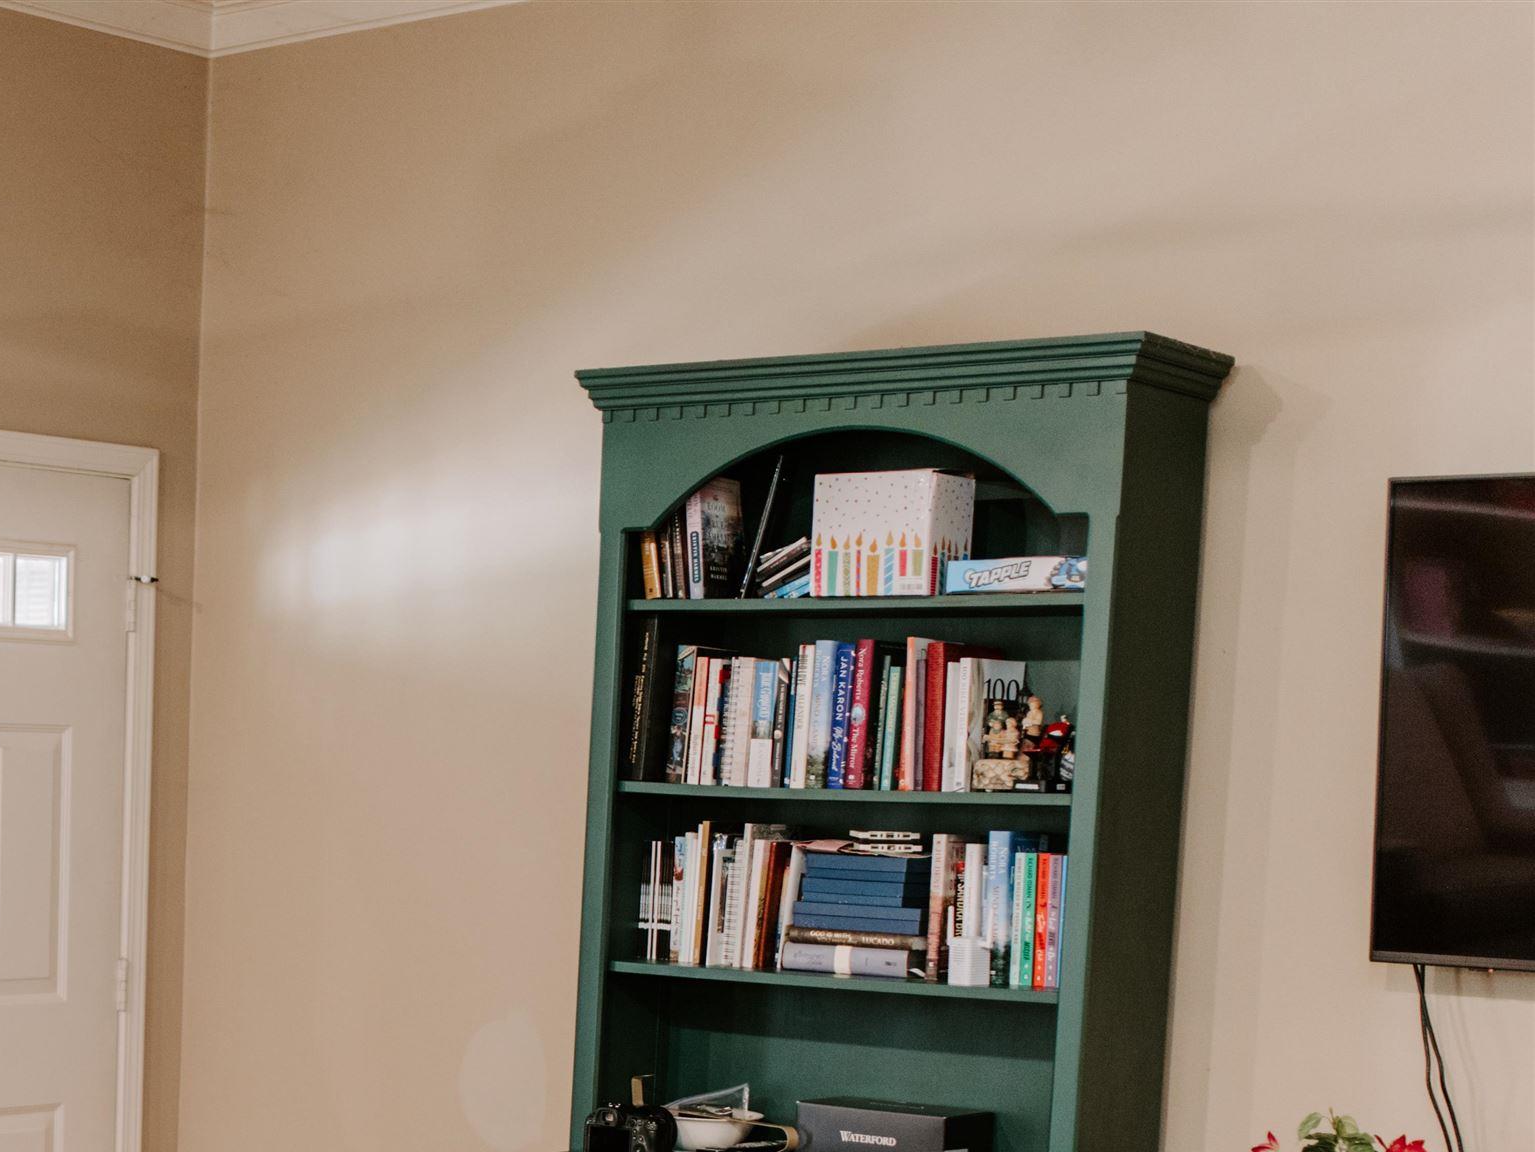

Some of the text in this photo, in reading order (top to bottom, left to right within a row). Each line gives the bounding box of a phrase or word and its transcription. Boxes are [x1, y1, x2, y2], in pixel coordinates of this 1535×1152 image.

[969, 560, 1032, 588] TAPPLE
[820, 655, 831, 682] NORA
[838, 656, 848, 678] JAN
[835, 682, 846, 721] KARON
[984, 678, 1020, 701] 100
[849, 647, 867, 769] Nora Roberts The Mirror
[998, 847, 1008, 874] NORA
[862, 936, 894, 945] LUCADO
[840, 1130, 897, 1147] WATERFORD
